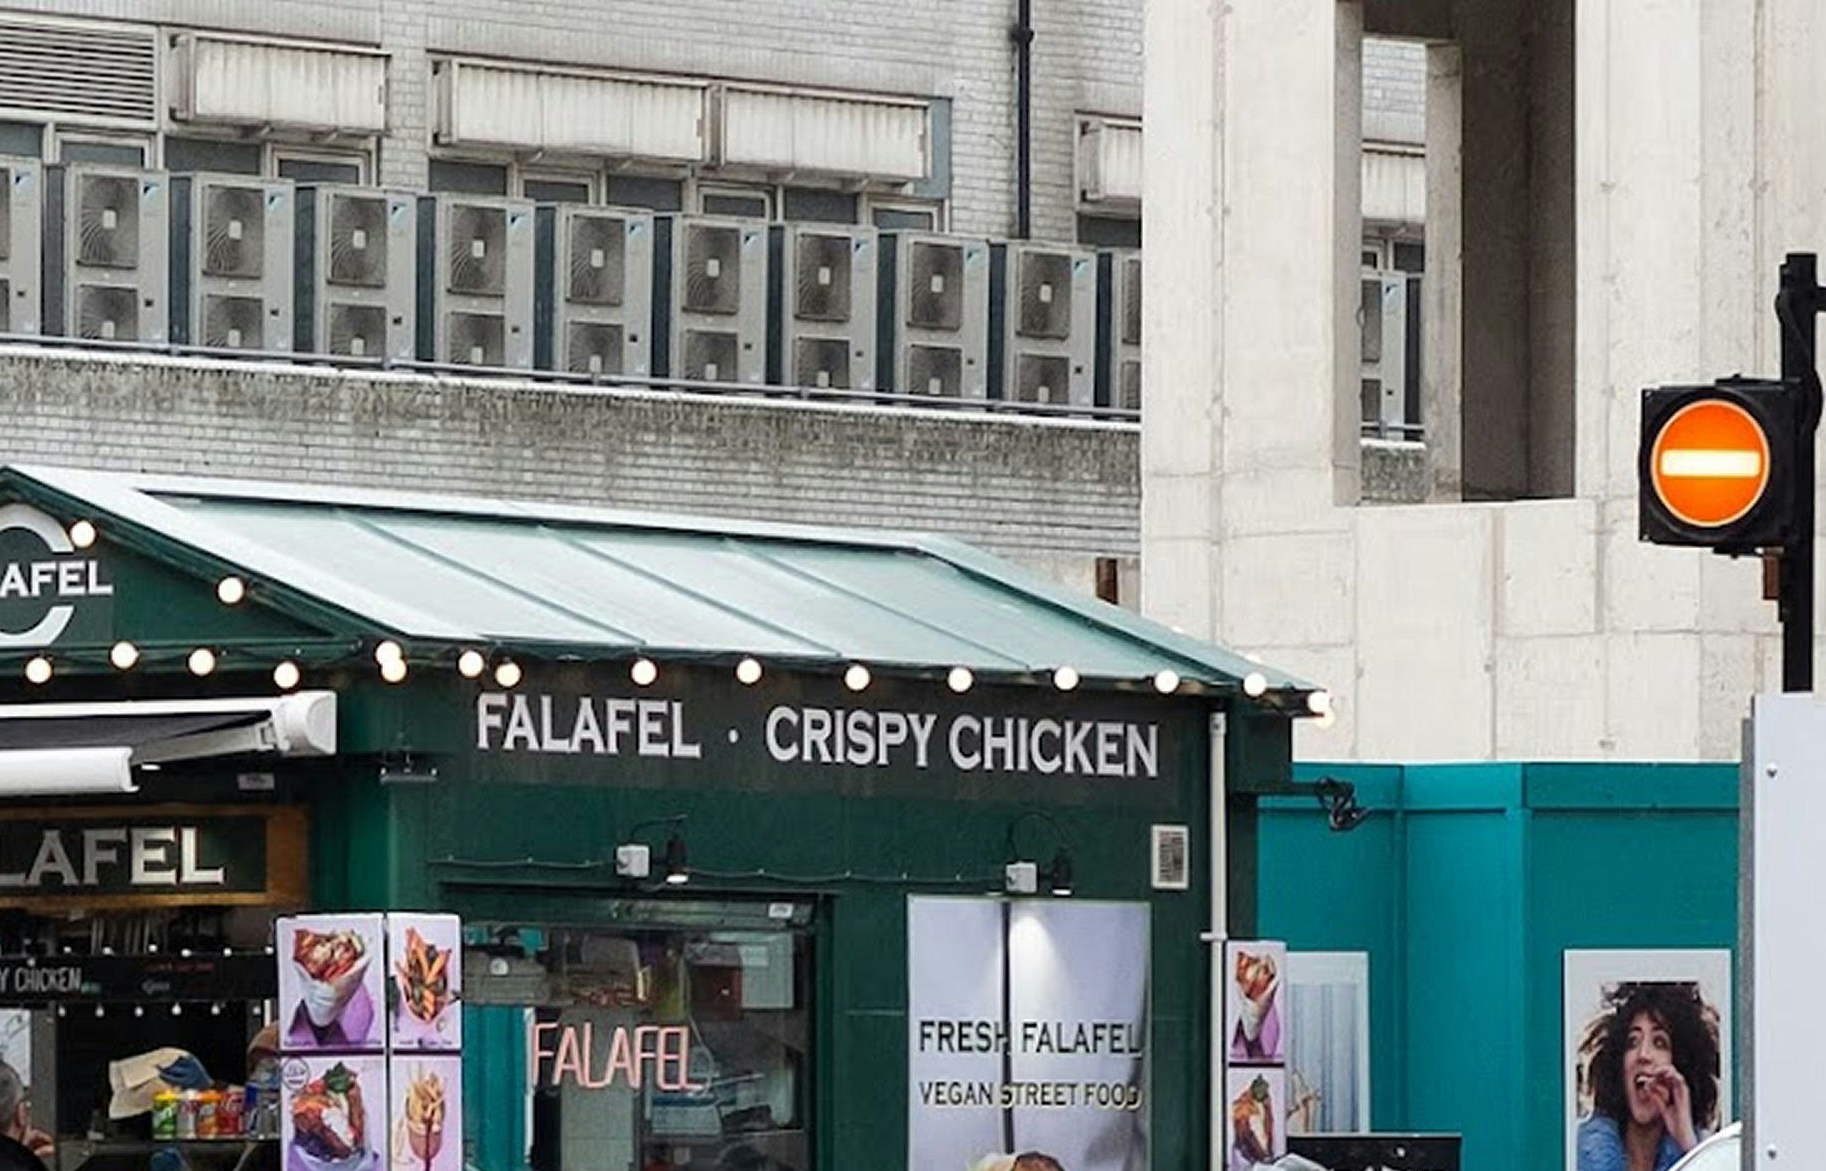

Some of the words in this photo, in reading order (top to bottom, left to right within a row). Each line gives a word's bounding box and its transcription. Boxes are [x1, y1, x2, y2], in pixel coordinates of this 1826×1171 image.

[477, 692, 701, 758] FALAFEL
[766, 706, 938, 768] CRISPY
[948, 715, 1159, 777] CHICKEN
[534, 1022, 704, 1091] FALAFEL
[919, 1020, 1010, 1054] FRESH
[1022, 1021, 1142, 1058] FALAFEL
[919, 1082, 993, 1106] VEGAN
[1000, 1082, 1078, 1108] STREET
[1084, 1084, 1141, 1110] FOOD
